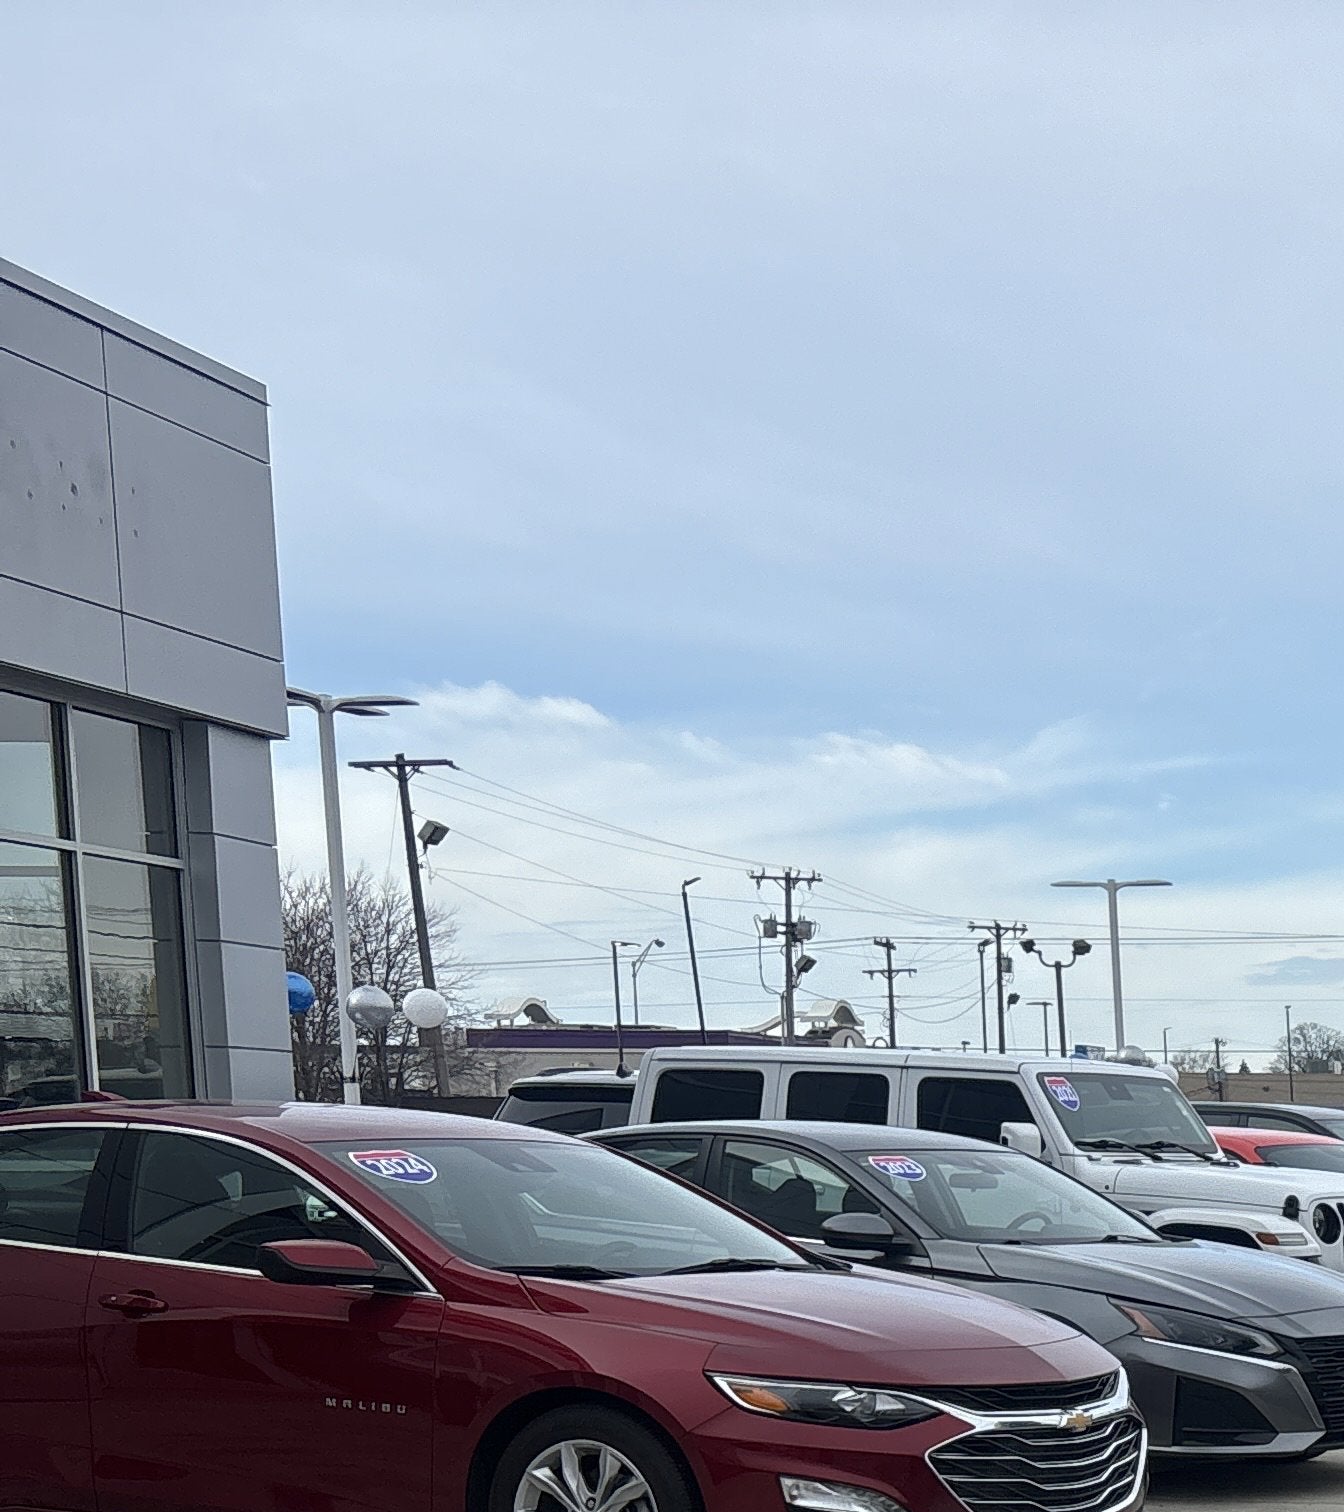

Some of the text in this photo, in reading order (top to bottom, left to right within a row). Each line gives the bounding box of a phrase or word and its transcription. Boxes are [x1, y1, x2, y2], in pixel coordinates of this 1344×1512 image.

[366, 1157, 431, 1175] 2024
[880, 1163, 922, 1174] 2023
[325, 1397, 407, 1414] MALIBU
